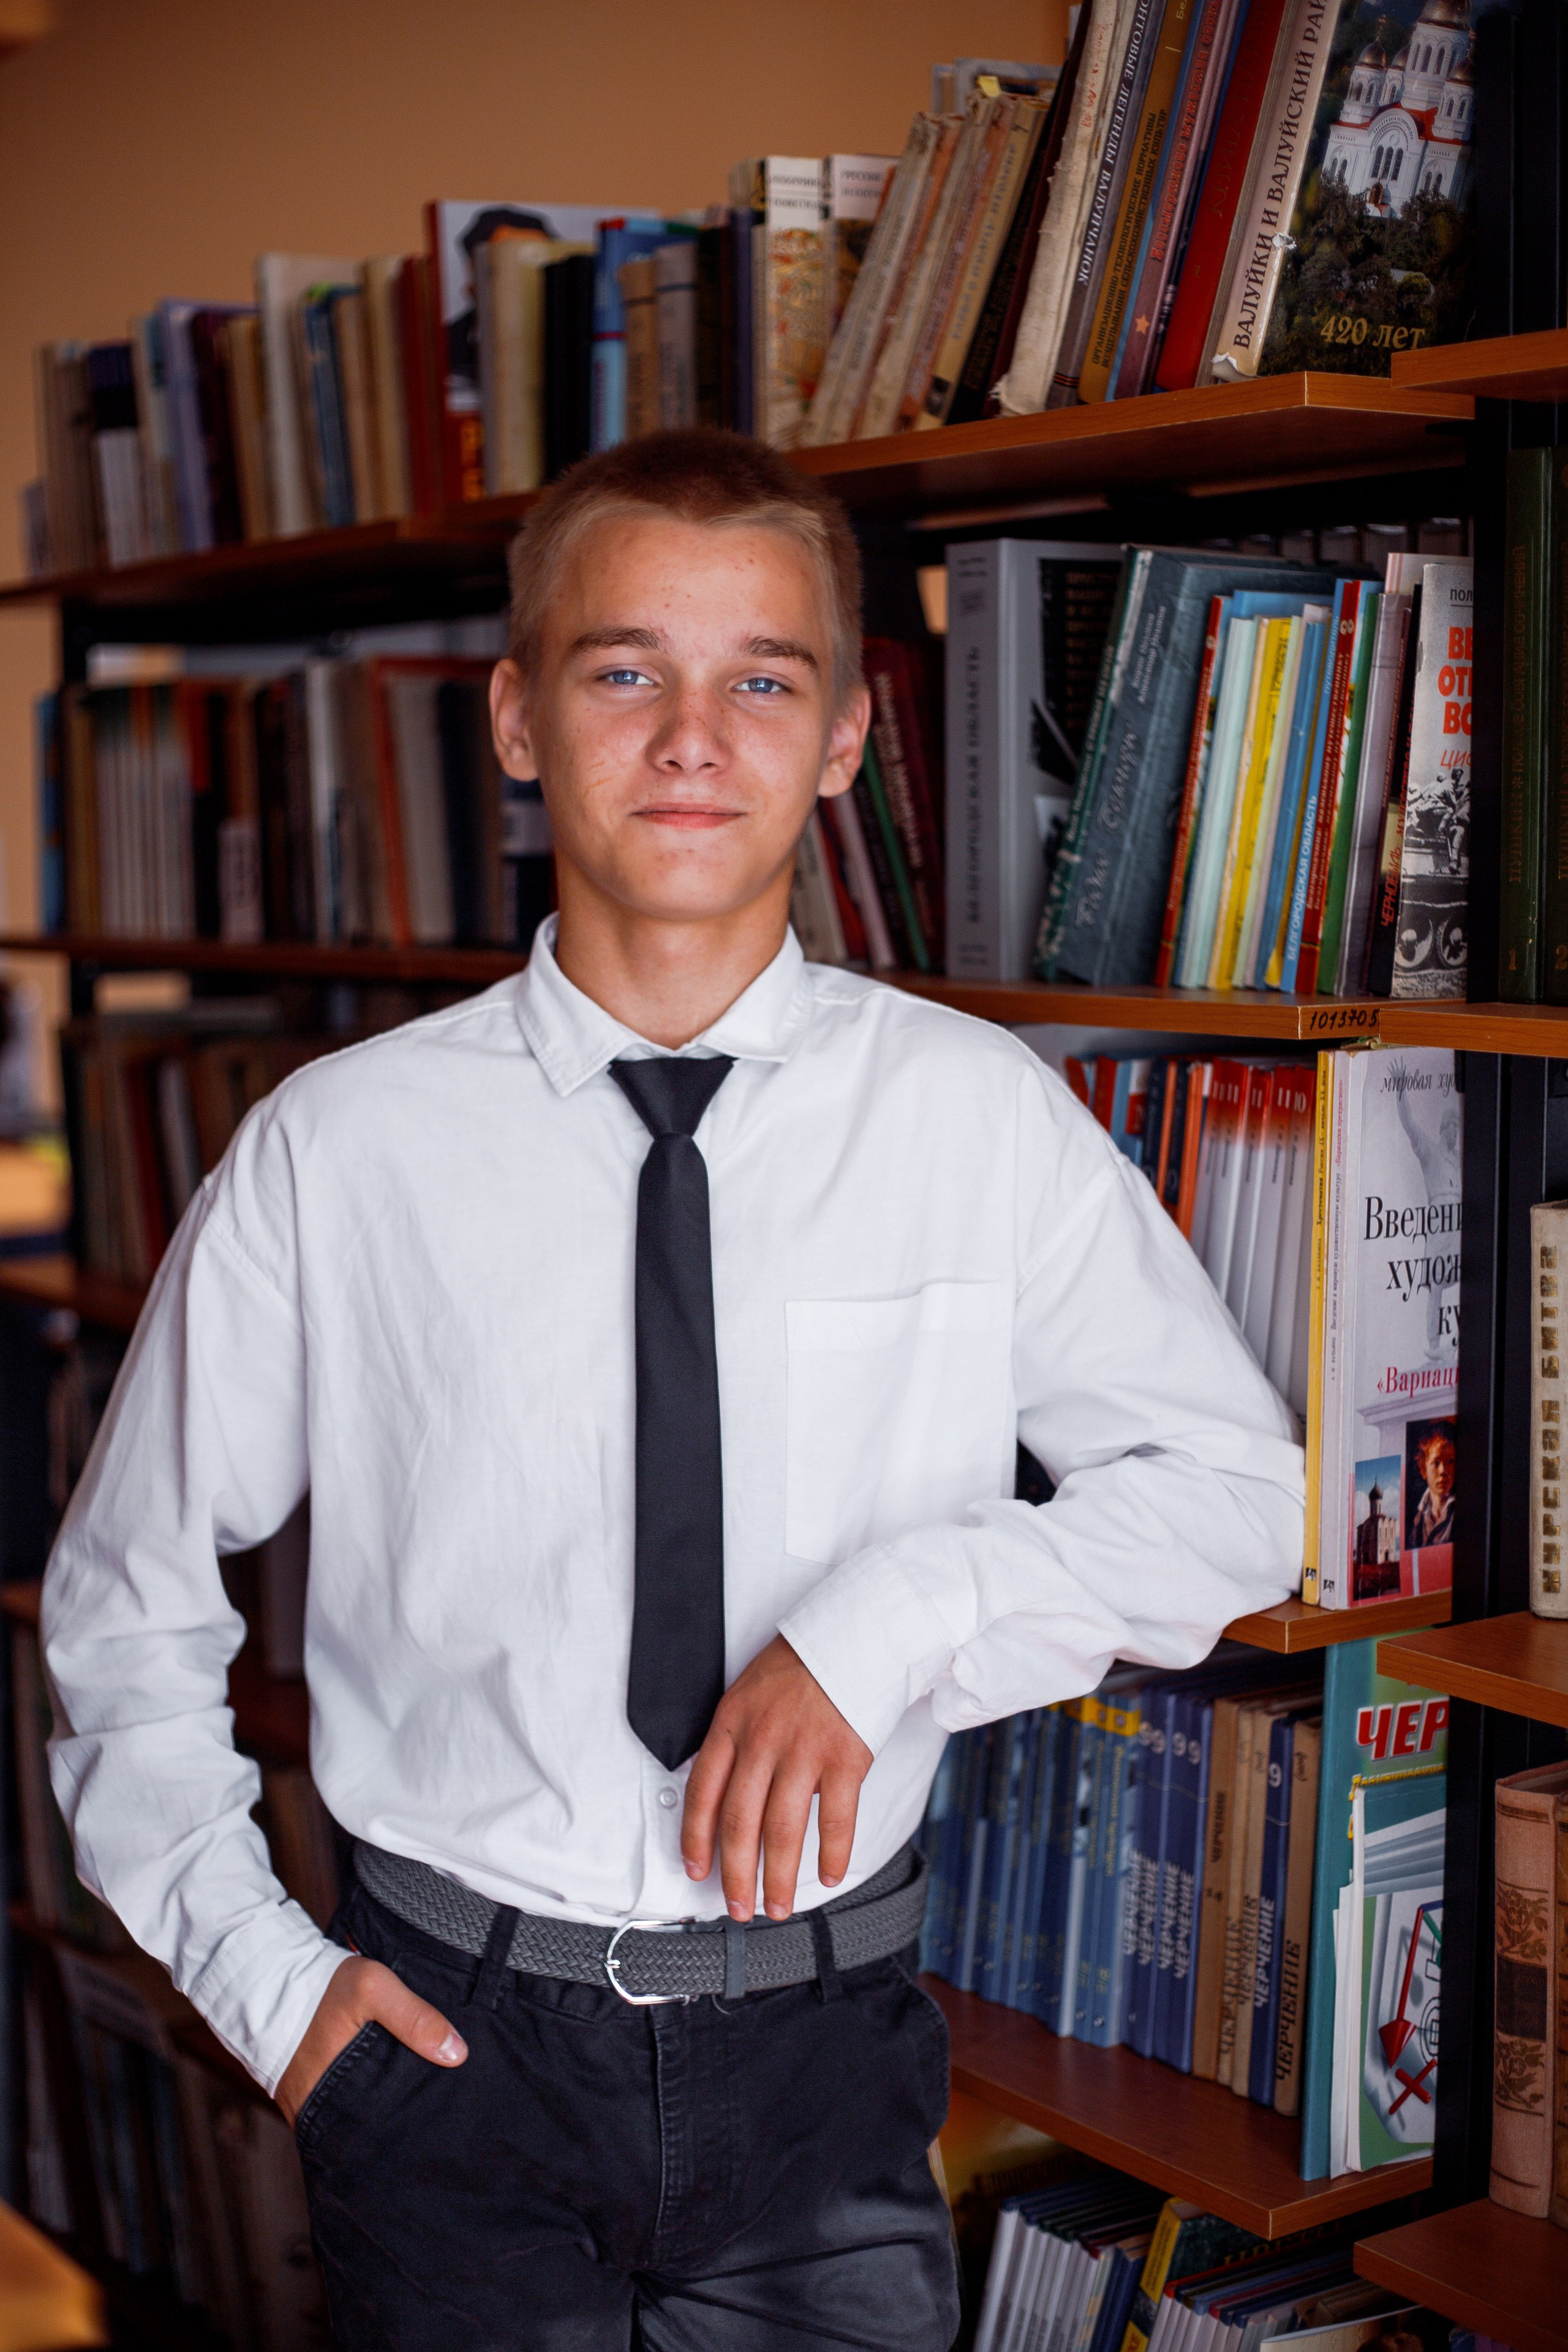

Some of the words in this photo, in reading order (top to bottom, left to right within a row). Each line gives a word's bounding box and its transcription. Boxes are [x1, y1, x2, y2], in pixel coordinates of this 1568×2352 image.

[1104, 83, 1130, 165] ЛЕГЕНДЫ
[1150, 108, 1167, 154] КУЛЬТУР
[1181, 50, 1208, 140] мужества
[1267, 50, 1315, 204] ВАЛУЙСКИЙ
[1136, 111, 1156, 176] НОРМАТИВЫ
[1077, 169, 1112, 286] ВАЛУЙЧАНОК
[1261, 208, 1280, 228] И
[1234, 232, 1274, 350] ВАЛУЙКИ
[1320, 316, 1368, 345] 420
[1373, 324, 1426, 349] лет
[1512, 545, 1526, 634] СОЧИНЕНИЙ
[1438, 665, 1472, 697] ОТ
[1513, 637, 1525, 711] СОБРАНИЕ
[1287, 859, 1308, 961] БЕЛГОРОДСКАЯ
[1301, 796, 1317, 856] ОБЛАСТЬ
[1509, 792, 1523, 883] ПУШКИН
[1381, 1068, 1432, 1101] мировая
[1540, 1245, 1559, 1379] БИТВА
[1541, 1400, 1561, 1594] КУРСКАЯ
[1356, 1695, 1450, 1762] ЧЕР
[1268, 1762, 1282, 1788] 9
[1138, 1856, 1158, 1966] ЧЕРЧЕНИЕ
[1158, 1860, 1180, 1970] ЧЕРЧЕНИЕ
[1174, 1869, 1194, 1979] ЧЕРЧЕНИЕ
[1254, 1896, 1275, 2008] ЧЕРЧЕНИЕ
[1276, 1939, 1301, 2081] ЧЕРЧЕНИЕ
